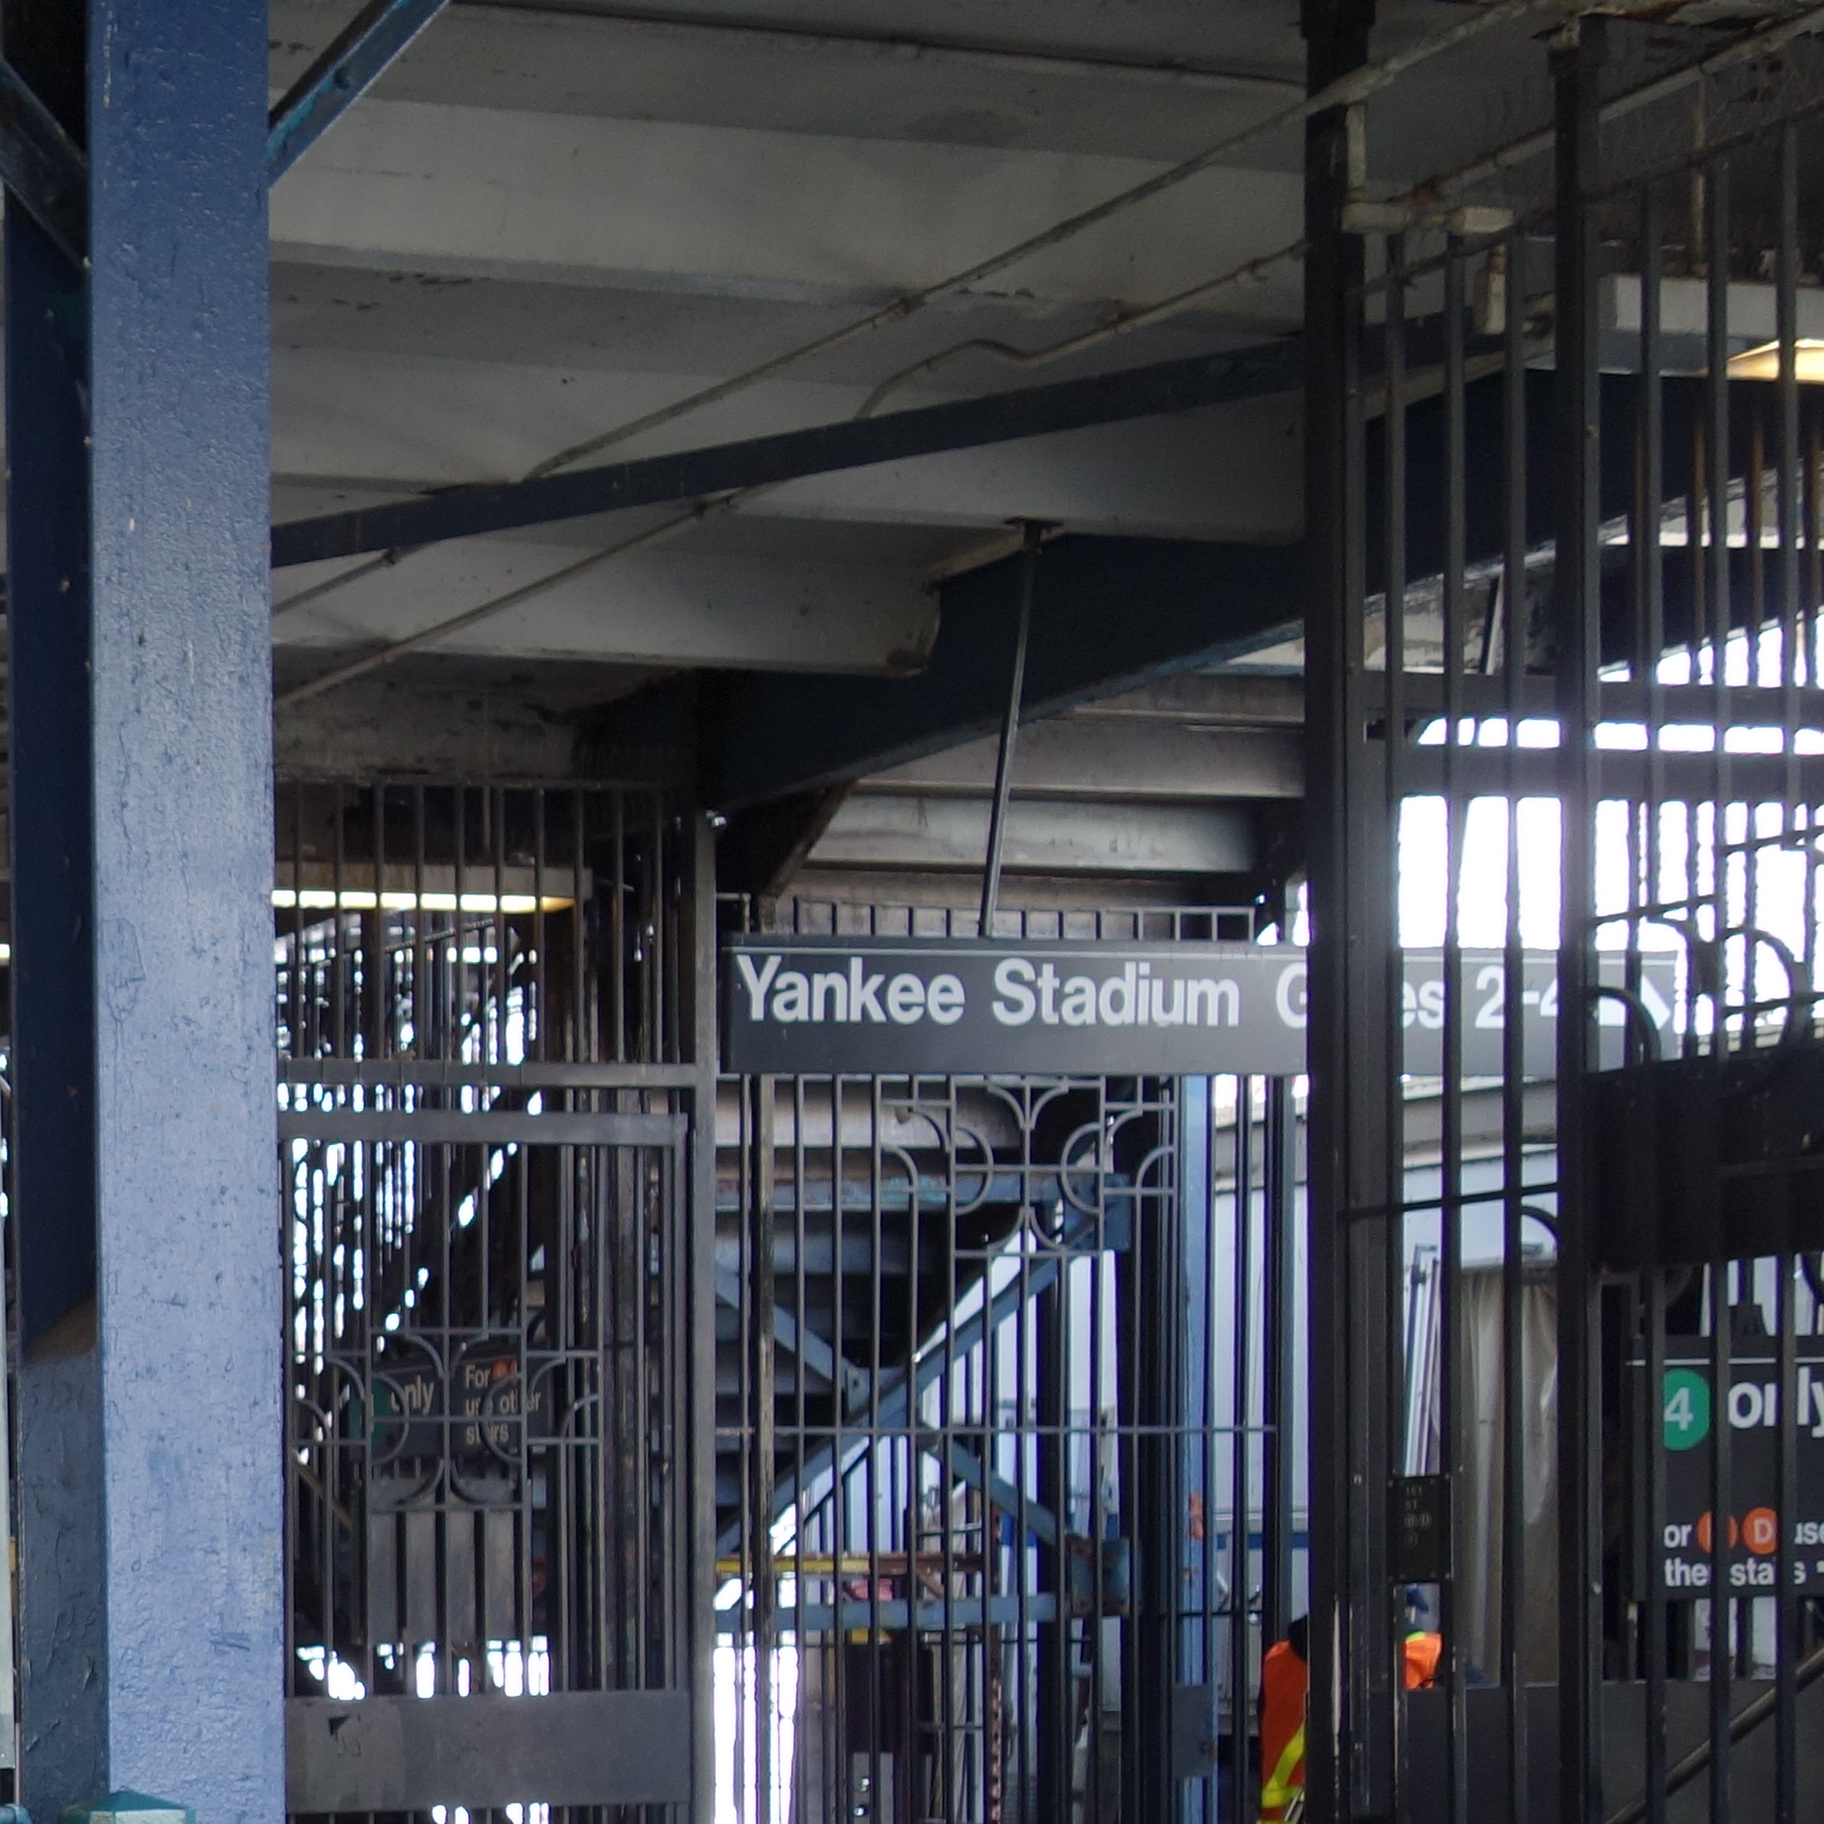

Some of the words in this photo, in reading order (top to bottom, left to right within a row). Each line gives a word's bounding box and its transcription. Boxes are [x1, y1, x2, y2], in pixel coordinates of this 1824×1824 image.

[737, 954, 965, 1024] Yankee
[992, 958, 1240, 1027] Stadium
[465, 1364, 490, 1389] For
